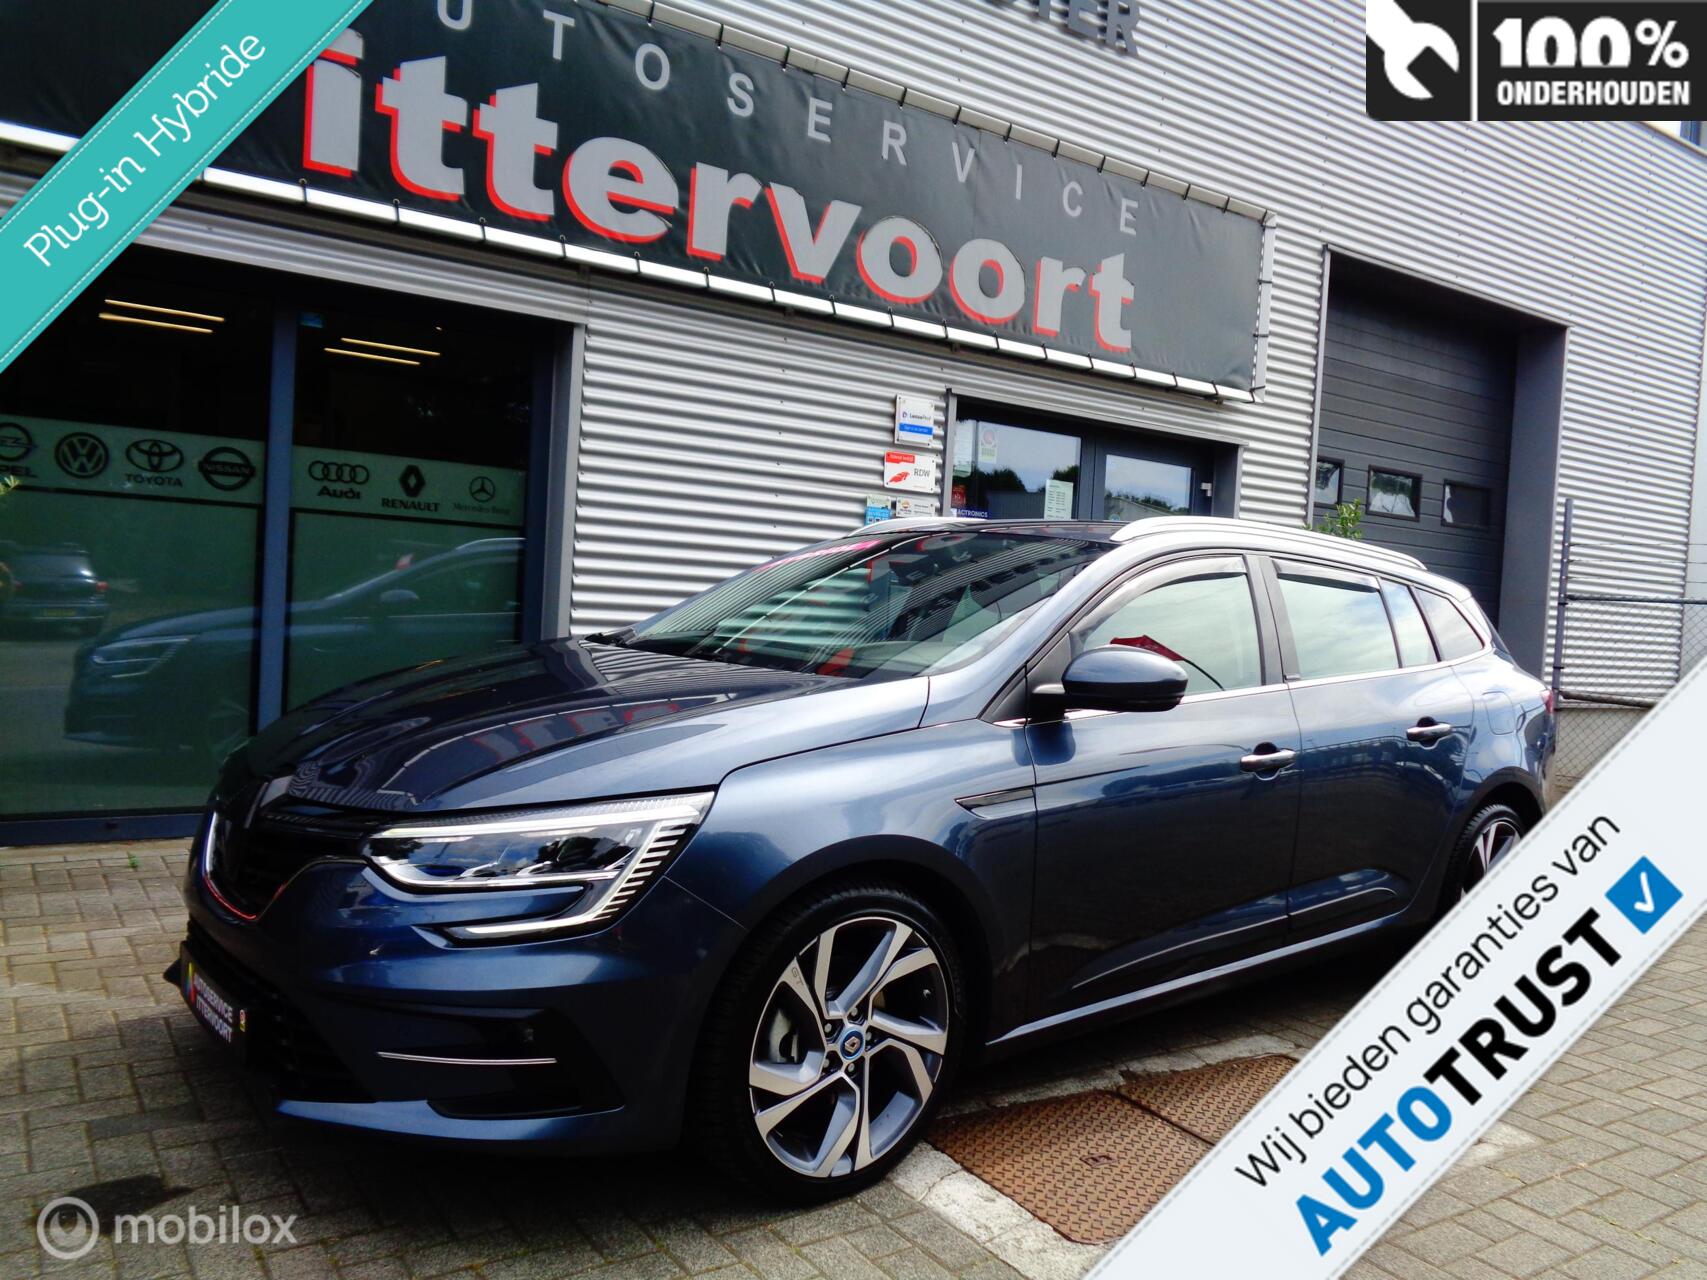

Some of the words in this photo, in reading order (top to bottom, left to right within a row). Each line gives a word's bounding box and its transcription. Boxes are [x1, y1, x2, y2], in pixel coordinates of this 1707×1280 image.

[913, 467, 931, 477] RDW
[124, 473, 184, 489] TOYOTA
[317, 485, 362, 500] Audi
[381, 497, 441, 512] RENAULT
